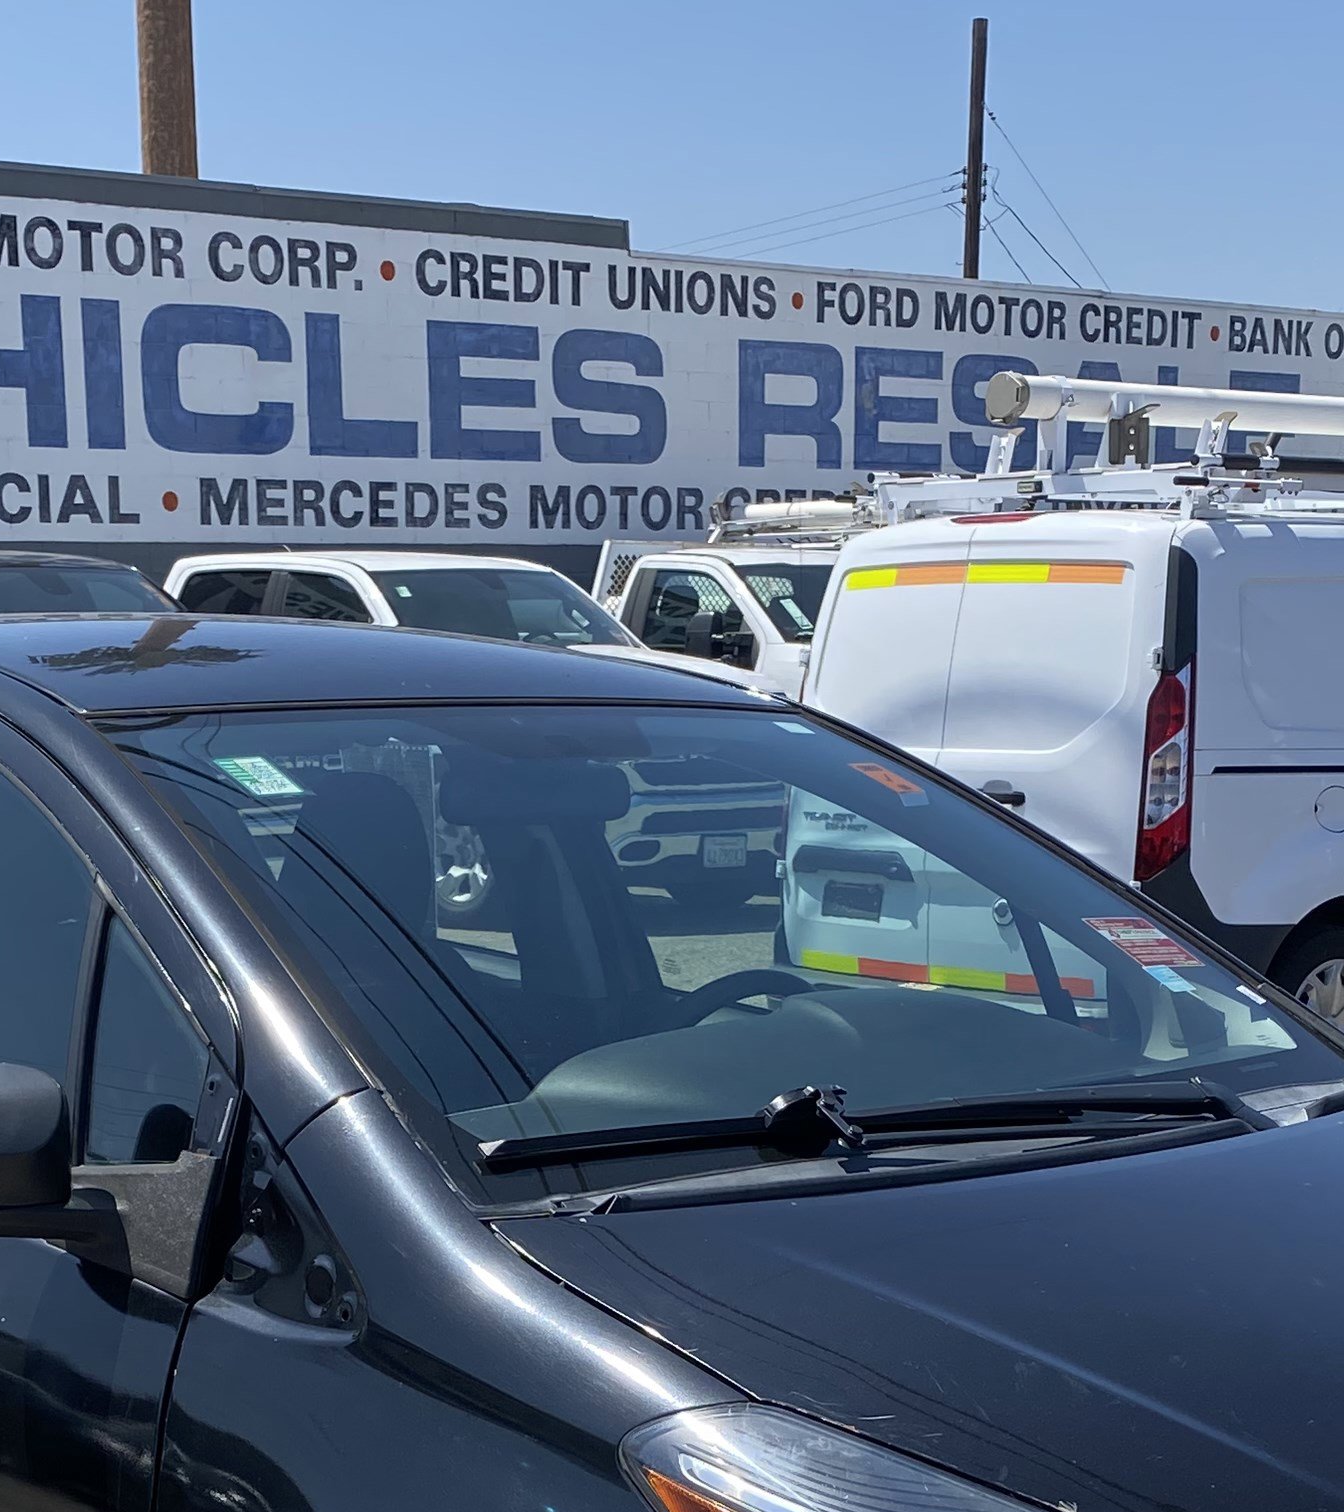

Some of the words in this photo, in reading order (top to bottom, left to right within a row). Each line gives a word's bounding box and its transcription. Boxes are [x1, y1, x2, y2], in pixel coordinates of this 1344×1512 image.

[208, 231, 363, 291] CORP.
[416, 248, 590, 307] CREDIT
[608, 264, 776, 320] UNIONS
[816, 281, 919, 328] FORD
[934, 291, 1067, 341] MOTOR
[1079, 302, 1202, 349] CREDIT
[1229, 315, 1314, 358] BANK
[199, 477, 509, 530] MERCEDES
[530, 484, 703, 532] MOTOR
